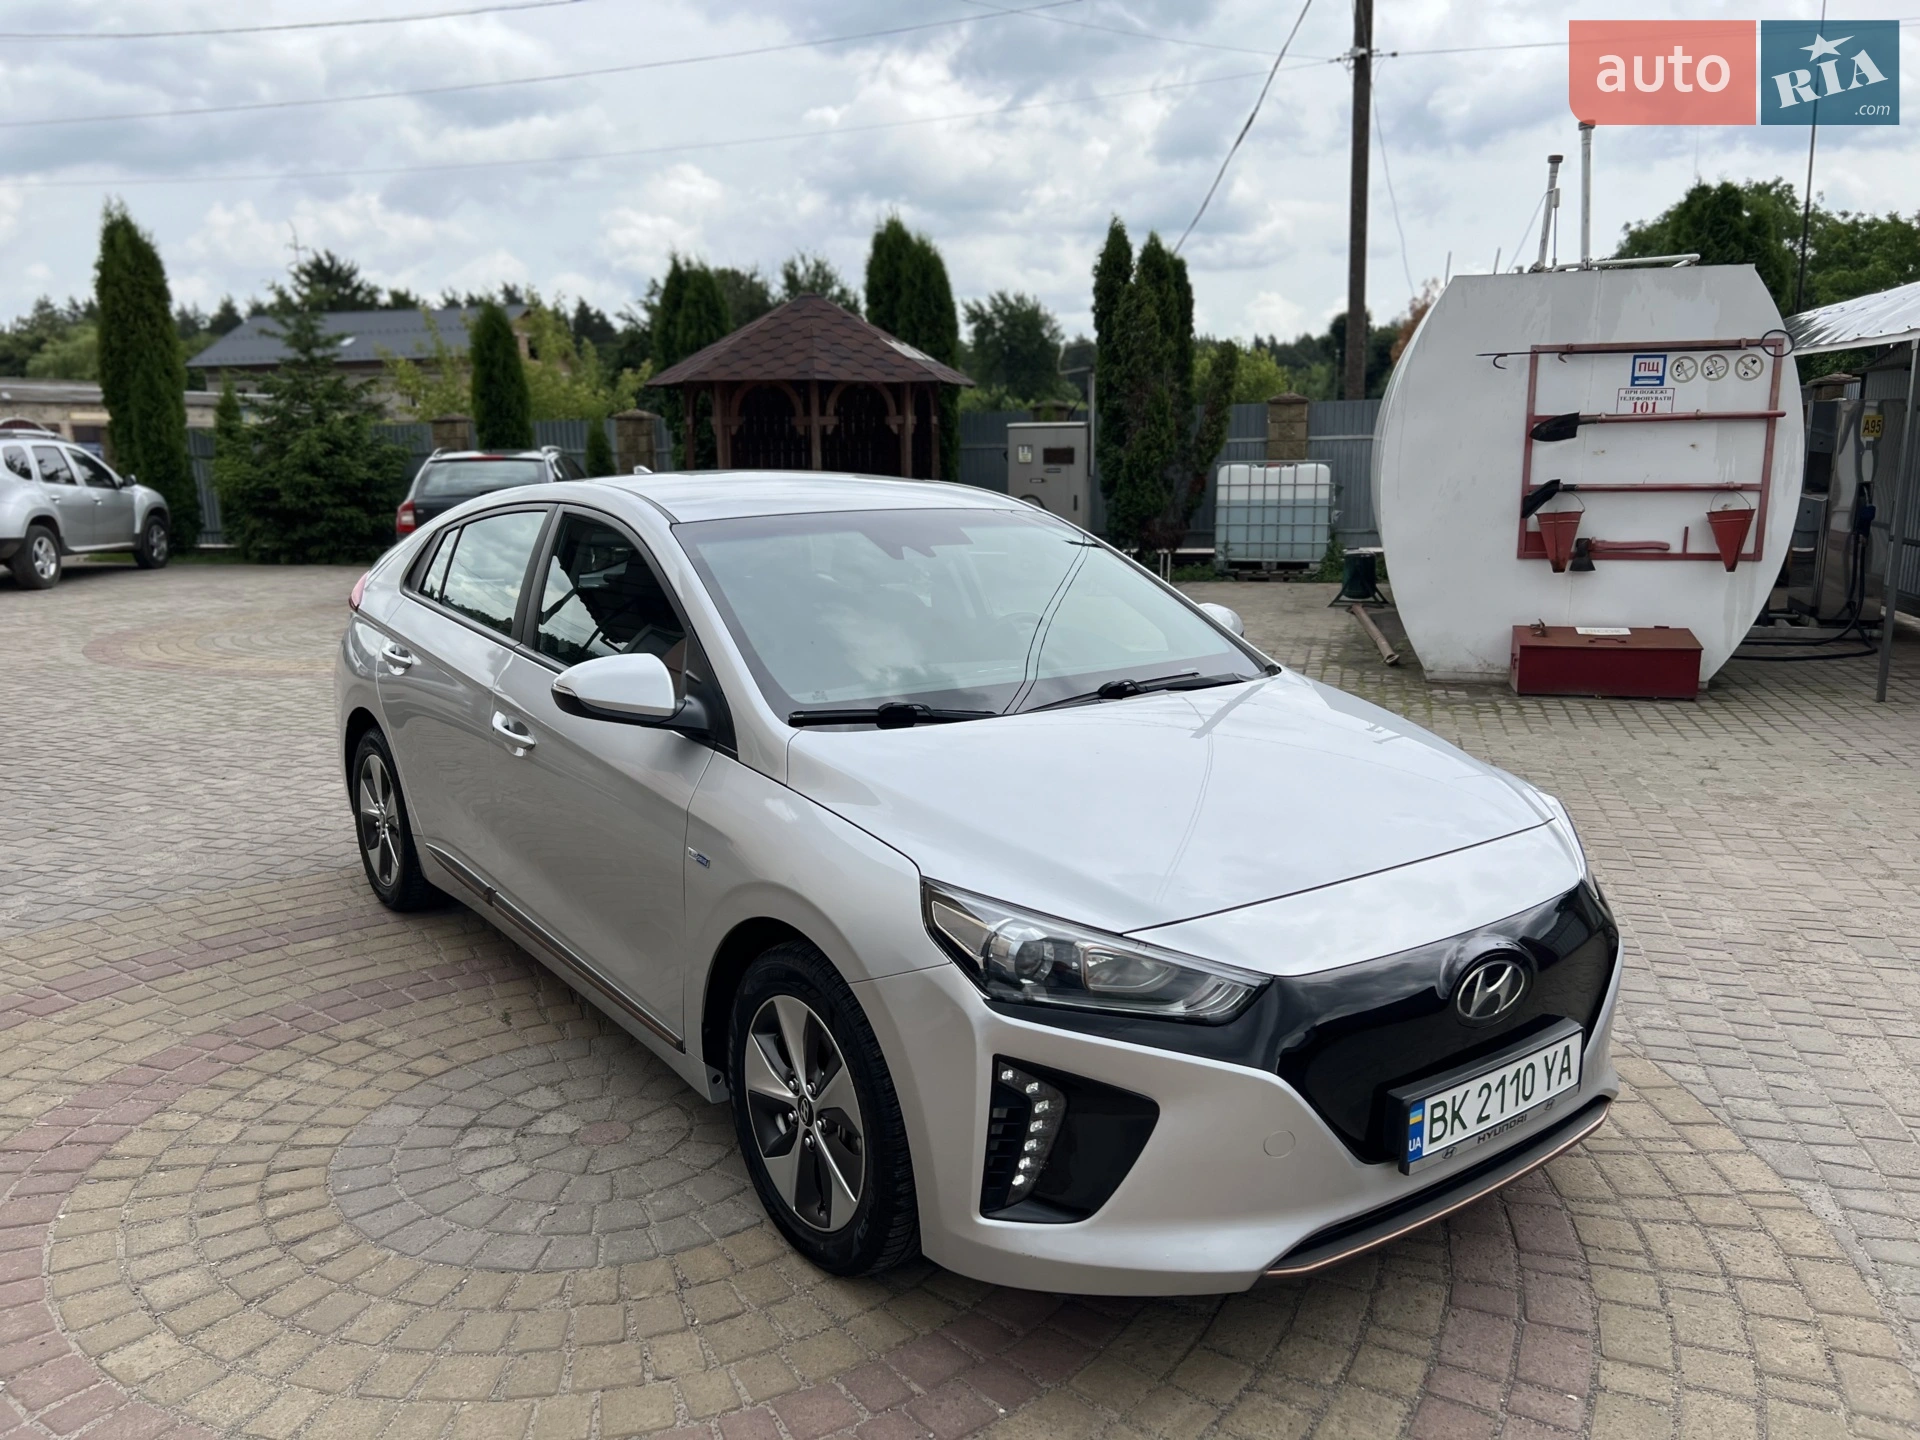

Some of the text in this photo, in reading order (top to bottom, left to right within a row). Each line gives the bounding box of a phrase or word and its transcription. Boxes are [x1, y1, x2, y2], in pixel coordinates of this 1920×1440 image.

[1638, 361, 1660, 374] ПЩ
[1632, 401, 1657, 414] 101
[1428, 1044, 1572, 1145] BK 2110 YA
[1477, 1114, 1528, 1145] HYUNDAI
[1409, 1136, 1422, 1152] UA
